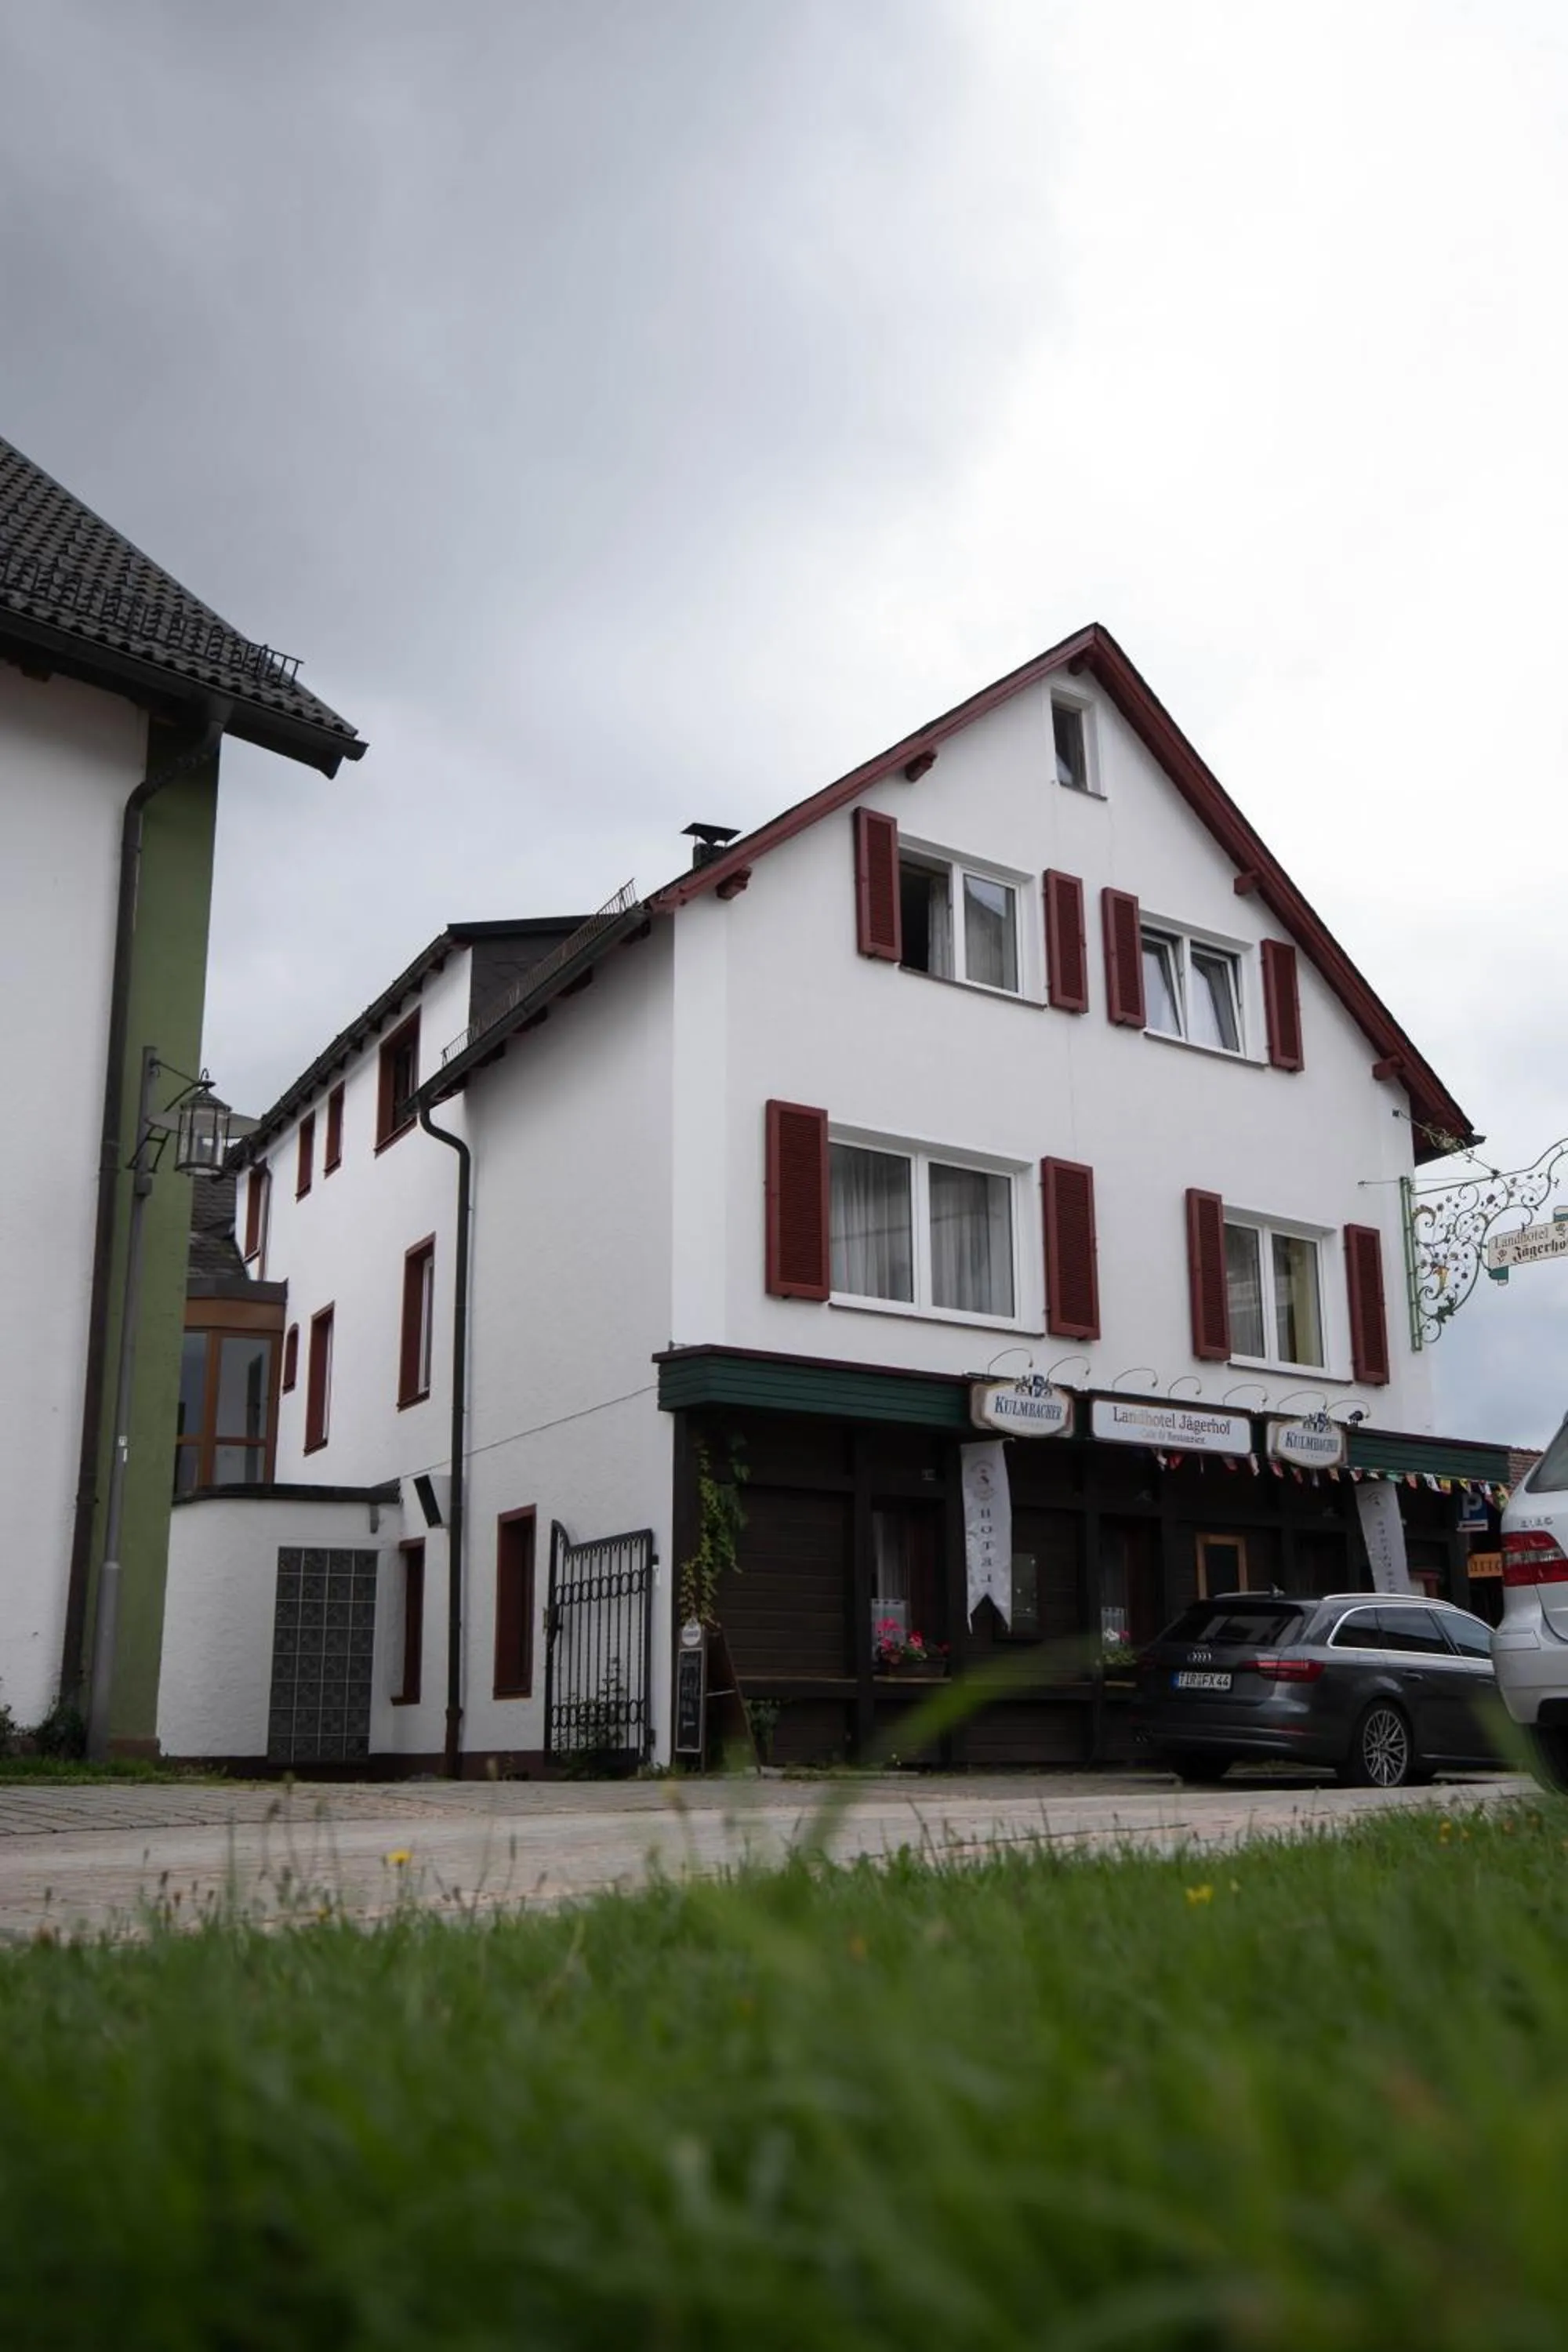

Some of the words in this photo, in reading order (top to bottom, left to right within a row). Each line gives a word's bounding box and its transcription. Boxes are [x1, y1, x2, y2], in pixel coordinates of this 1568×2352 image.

[1493, 1226, 1548, 1248] Landhotel
[1513, 1239, 1568, 1263] Jägerho
[994, 1396, 1062, 1420] KULMBACHER
[1113, 1406, 1176, 1429] Landhotel
[1178, 1414, 1231, 1436] Jägerhof
